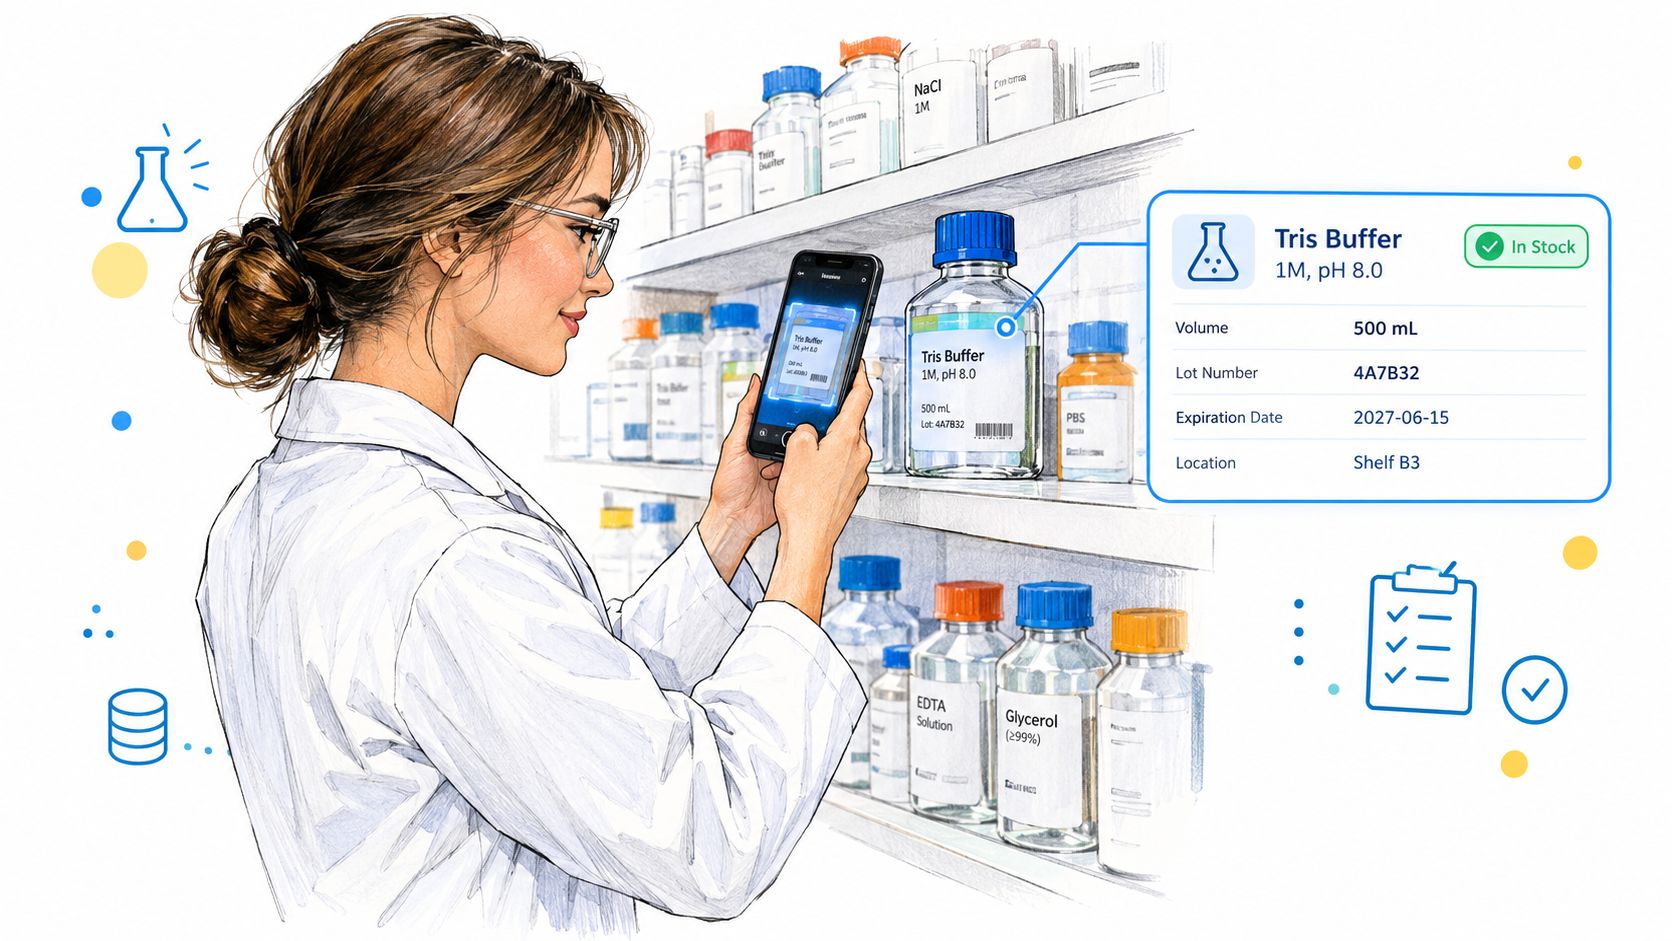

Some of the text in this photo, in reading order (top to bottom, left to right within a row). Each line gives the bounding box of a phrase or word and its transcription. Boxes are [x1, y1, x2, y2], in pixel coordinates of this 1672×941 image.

[914, 78, 942, 97] NaCl
[914, 100, 930, 115] 1M
[921, 348, 985, 364] Tris Buffer
[921, 367, 977, 383] 1M, pH 8.0
[920, 403, 951, 414] 500 mL
[920, 420, 965, 429] Lot: 4A7B32
[1066, 412, 1086, 424] PBS
[917, 695, 947, 713] EDTA
[916, 714, 954, 732] Solution
[1005, 708, 1059, 729] Glycerol
[1005, 731, 1041, 747] (≥99%)
